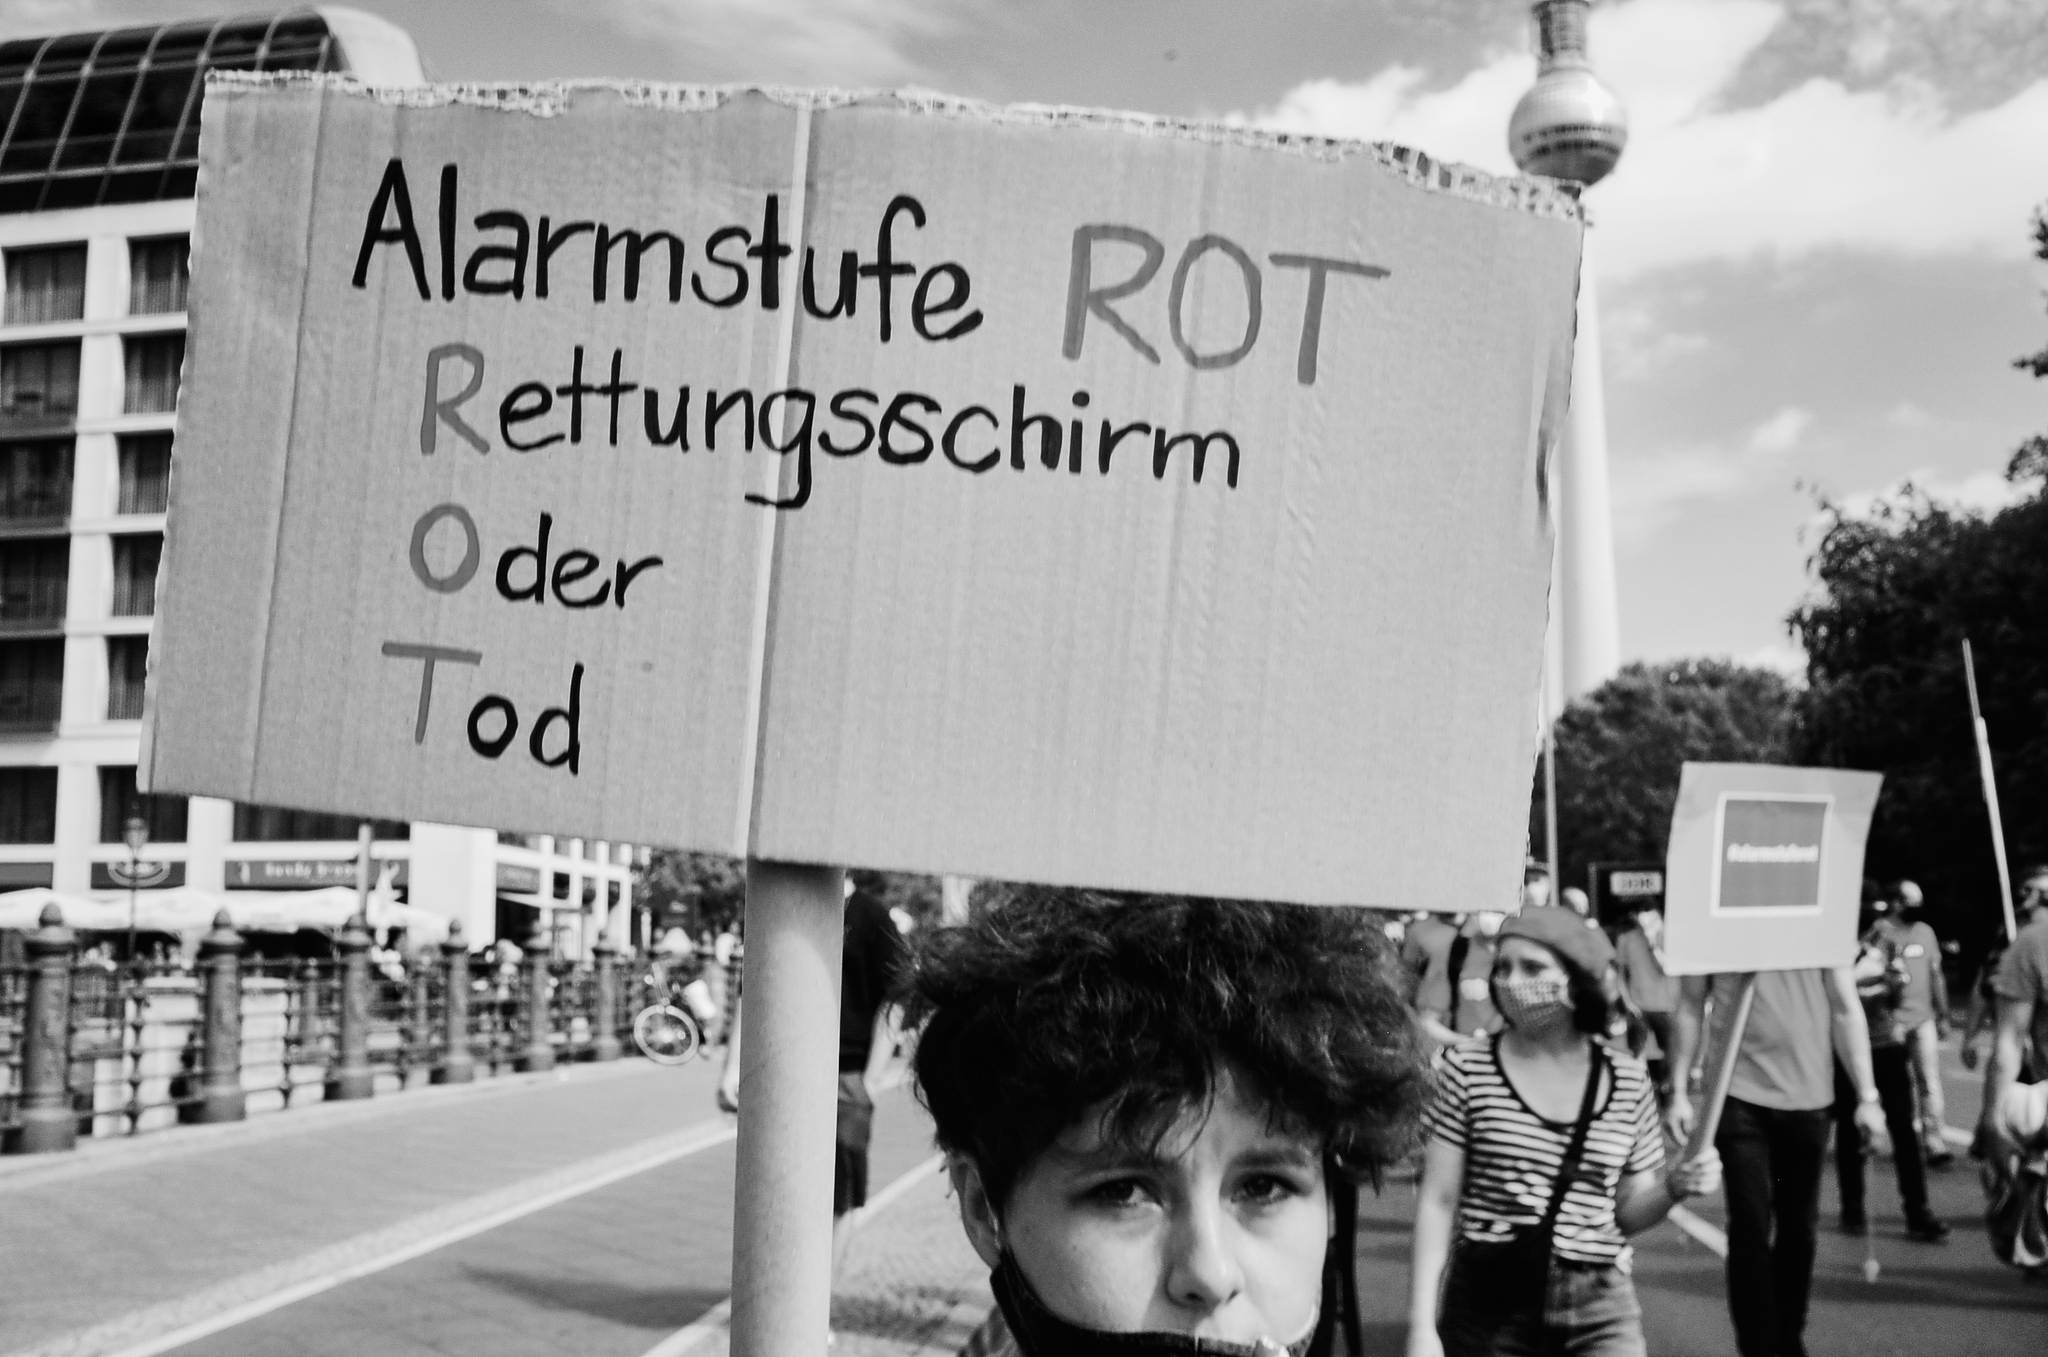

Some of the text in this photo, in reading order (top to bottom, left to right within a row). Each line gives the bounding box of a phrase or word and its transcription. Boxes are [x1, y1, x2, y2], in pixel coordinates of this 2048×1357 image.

[351, 155, 1392, 386] Alarmstufe ROT
[419, 342, 1242, 509] Rettungsschirm
[408, 502, 665, 611] Oder
[381, 640, 585, 777] Tod
